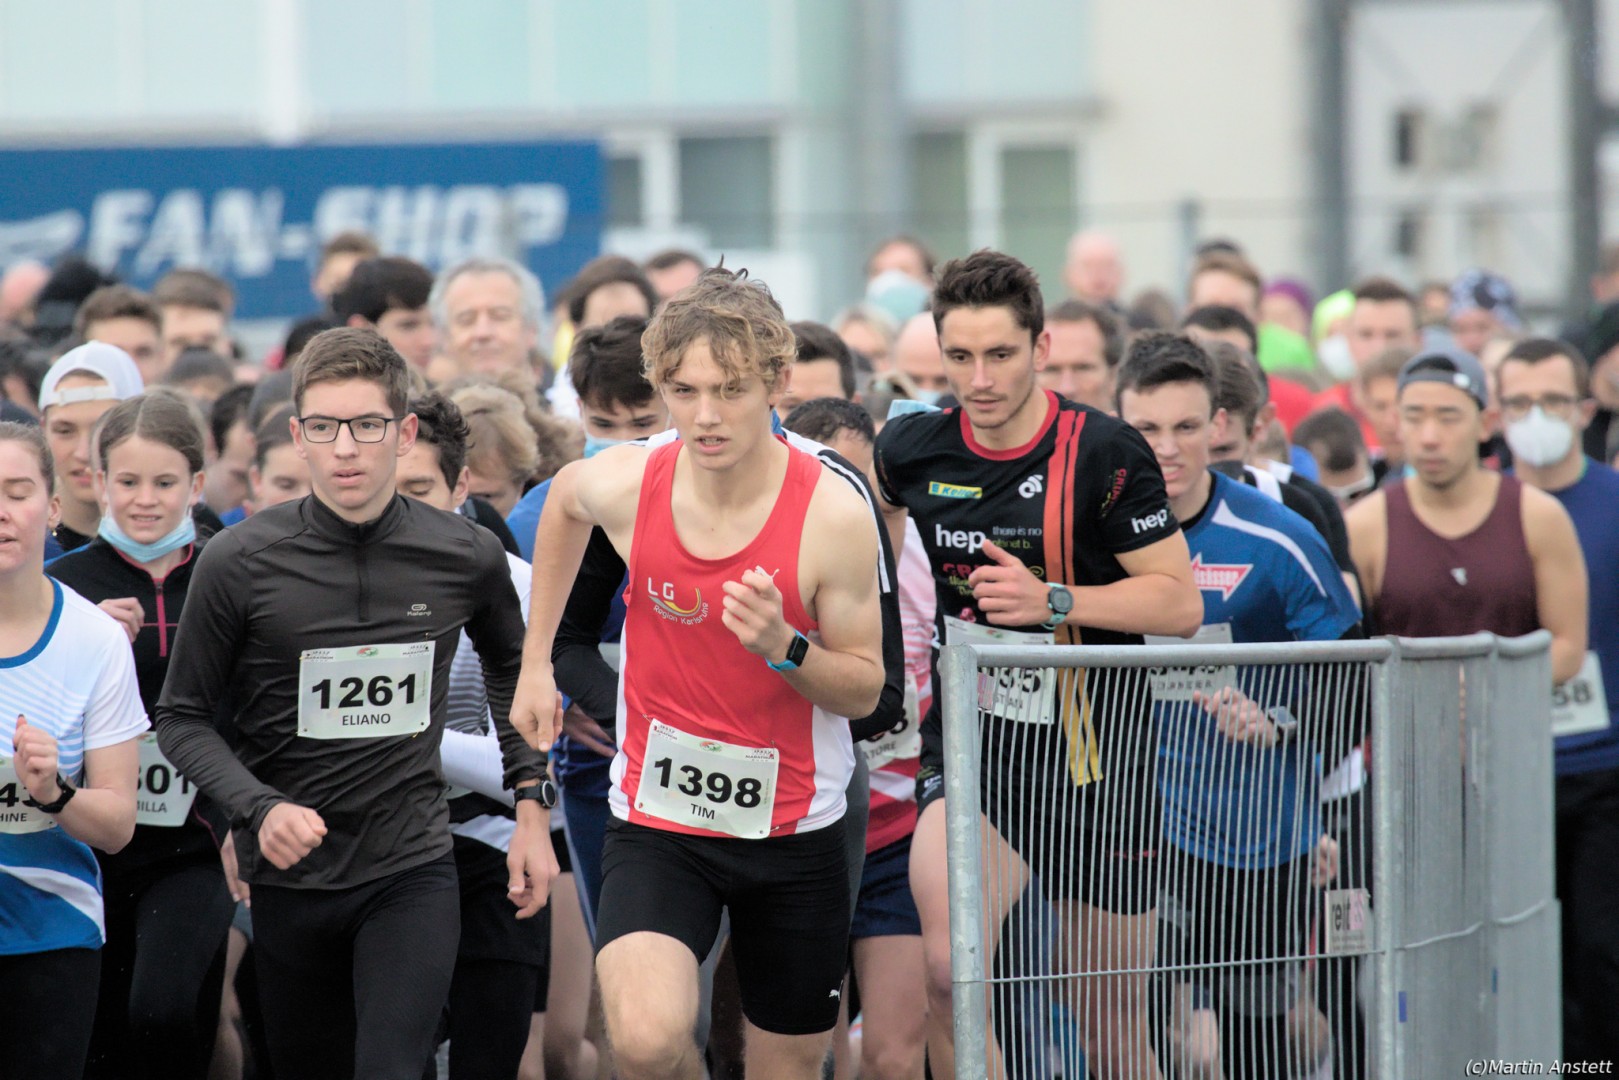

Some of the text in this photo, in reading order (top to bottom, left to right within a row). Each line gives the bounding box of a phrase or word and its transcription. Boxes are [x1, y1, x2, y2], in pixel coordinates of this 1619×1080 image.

[1028, 527, 1043, 536] no
[1131, 508, 1167, 534] hep
[935, 523, 986, 554] hep
[653, 602, 709, 626] Region Karlsruhe
[312, 673, 416, 709] 1261
[342, 713, 391, 726] ELIANO
[654, 757, 762, 808] 1398
[690, 803, 715, 820] TIM
